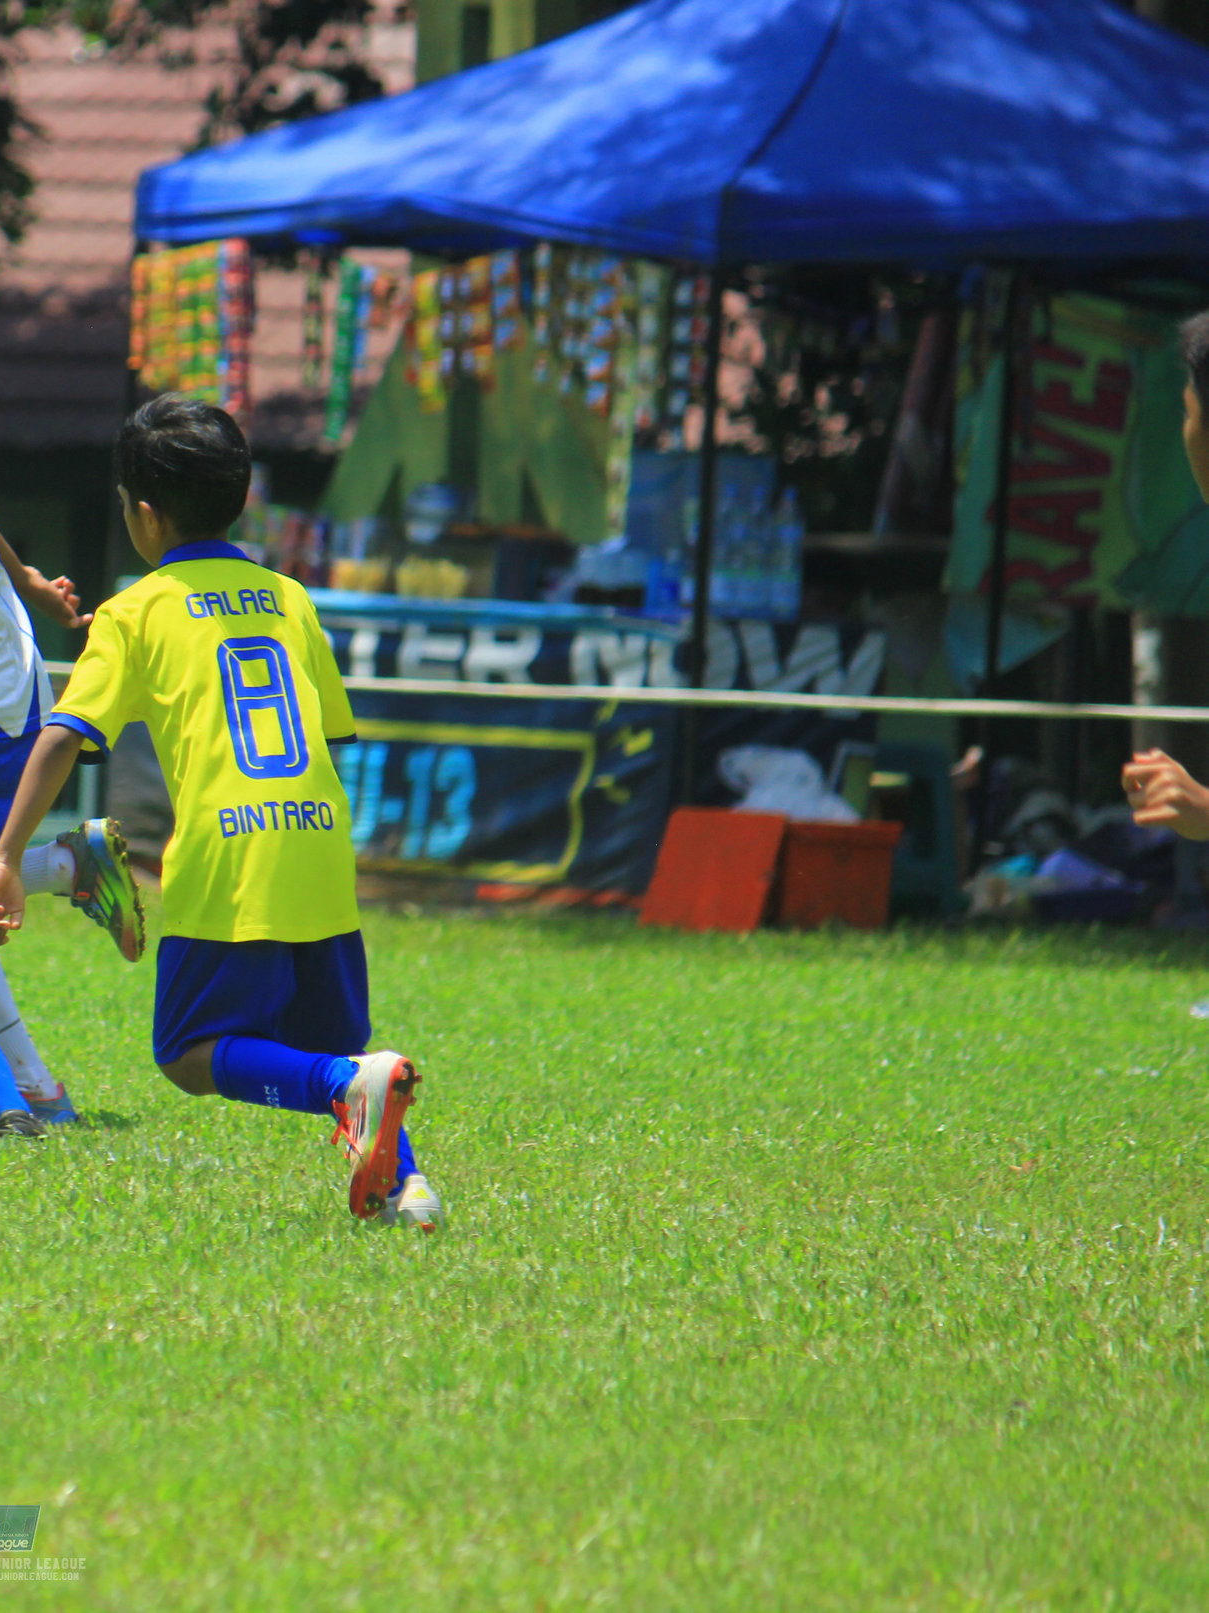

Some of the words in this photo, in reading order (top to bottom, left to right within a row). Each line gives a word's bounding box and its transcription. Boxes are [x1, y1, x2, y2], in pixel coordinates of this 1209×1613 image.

[185, 588, 286, 619] GALAEL
[217, 635, 310, 780] 8
[219, 800, 334, 839] BINTARO
